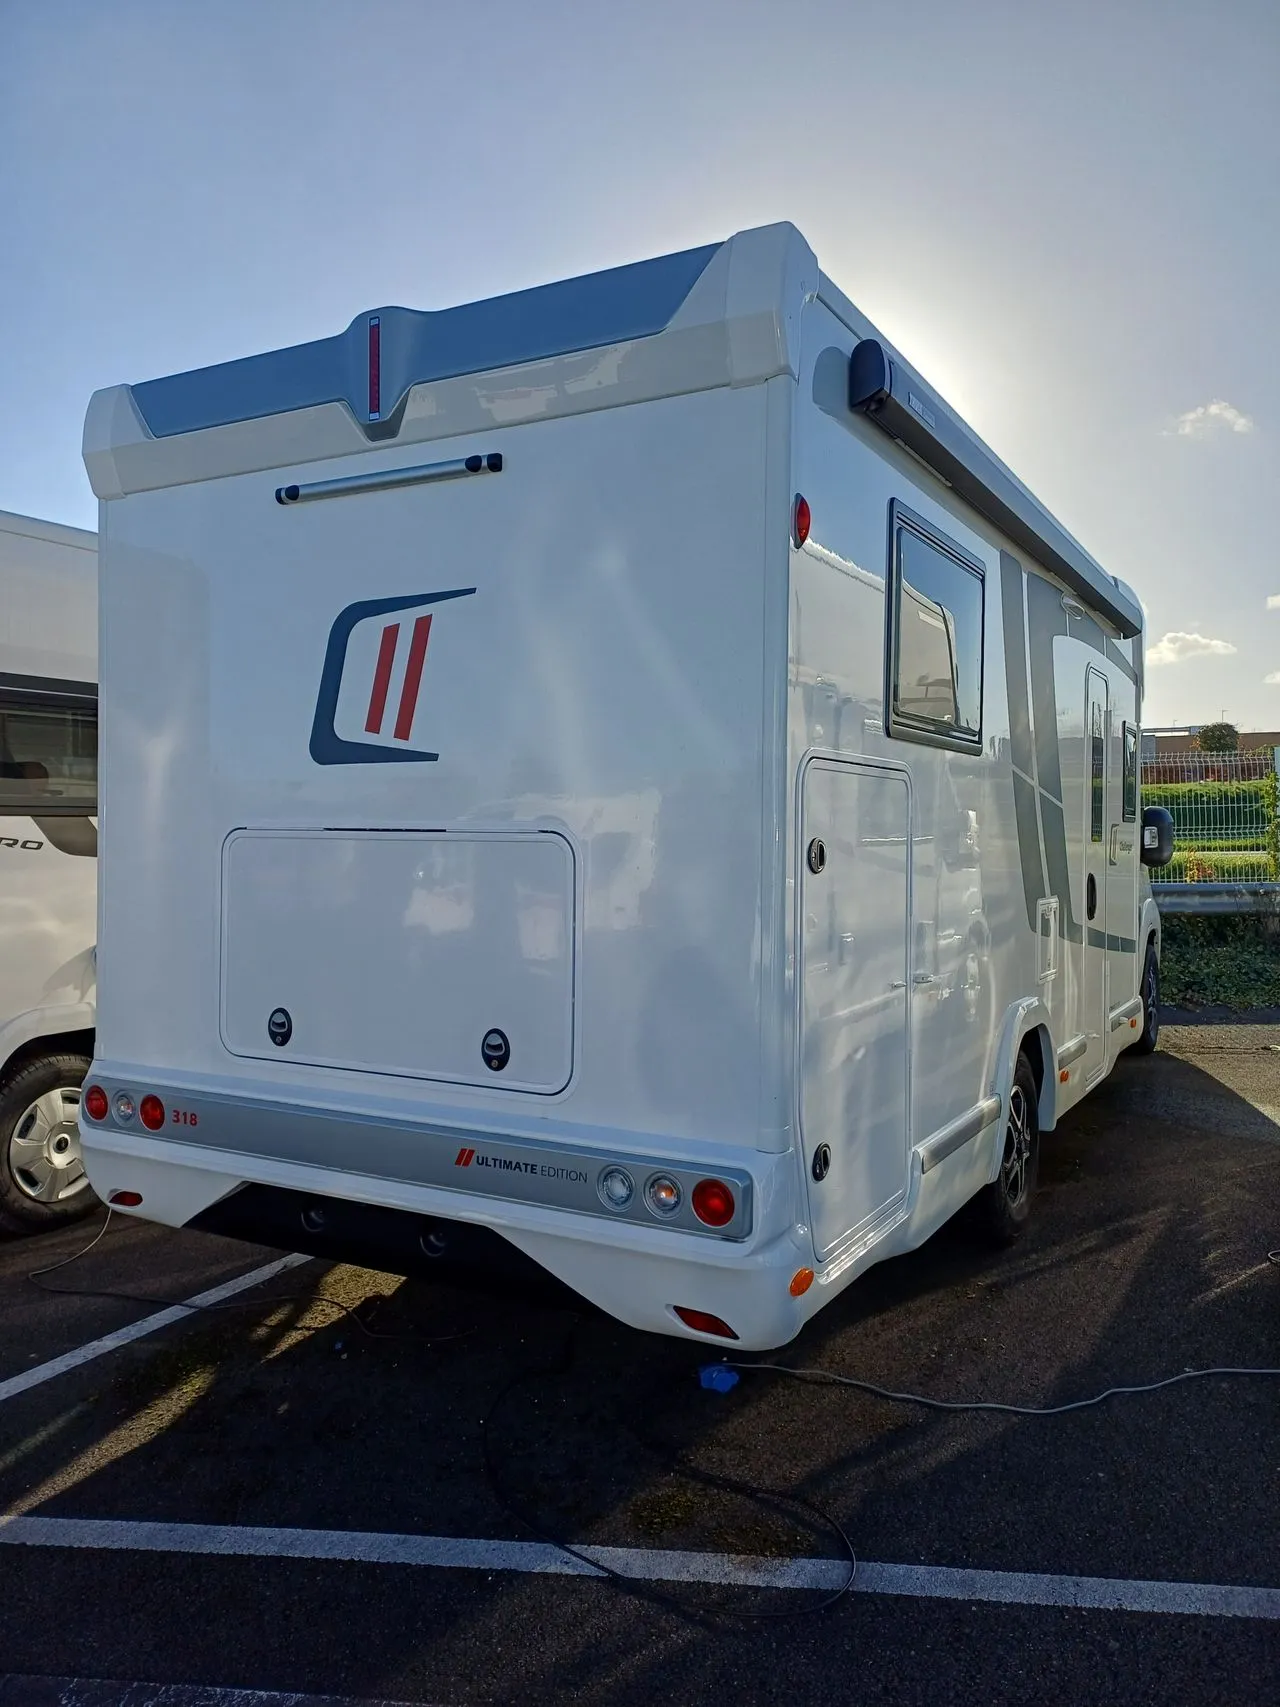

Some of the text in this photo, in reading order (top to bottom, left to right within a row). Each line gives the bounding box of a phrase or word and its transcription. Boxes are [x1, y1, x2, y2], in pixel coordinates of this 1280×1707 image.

[172, 1109, 198, 1127] 318
[476, 1155, 588, 1183] ULTIMATE EDITION
